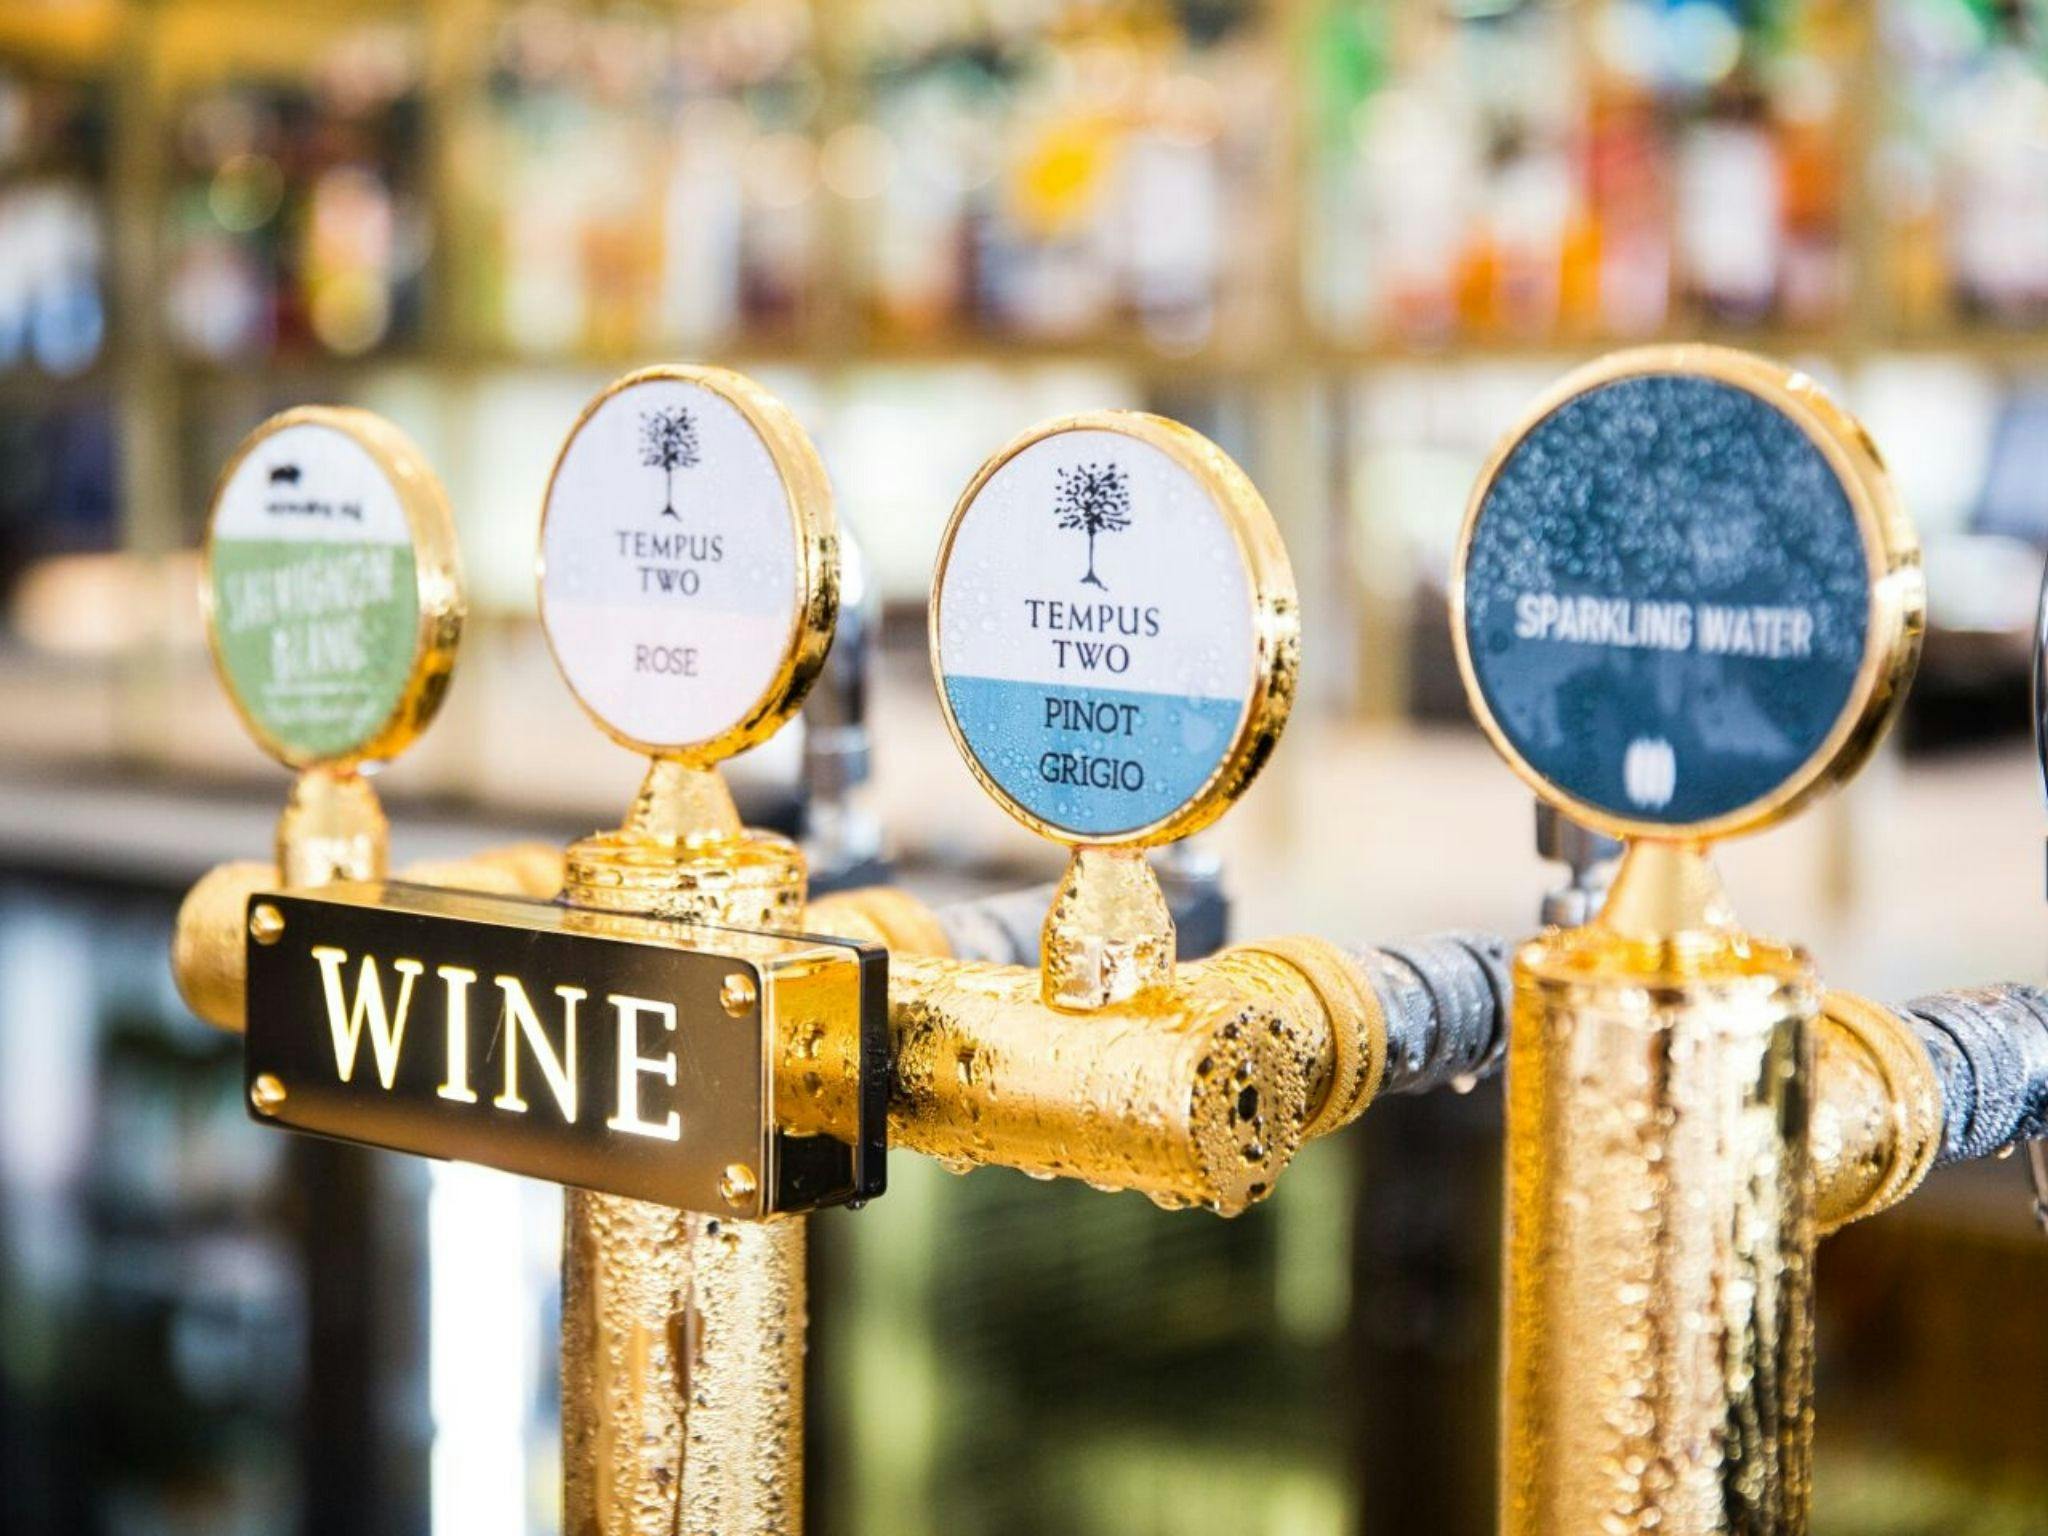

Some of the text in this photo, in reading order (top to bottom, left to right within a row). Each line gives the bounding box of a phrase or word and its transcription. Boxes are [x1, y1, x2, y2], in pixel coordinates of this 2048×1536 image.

[616, 530, 723, 562] TEMPUS
[637, 566, 700, 596] TWO
[1025, 599, 1160, 637] TEMPUS
[1514, 594, 1813, 658] SPARKLING WATER
[635, 644, 698, 677] ROSE
[1051, 639, 1130, 674] TWO
[1044, 697, 1139, 736] PINOT
[1039, 751, 1144, 792] GRIGIO
[311, 945, 681, 1142] WINE
